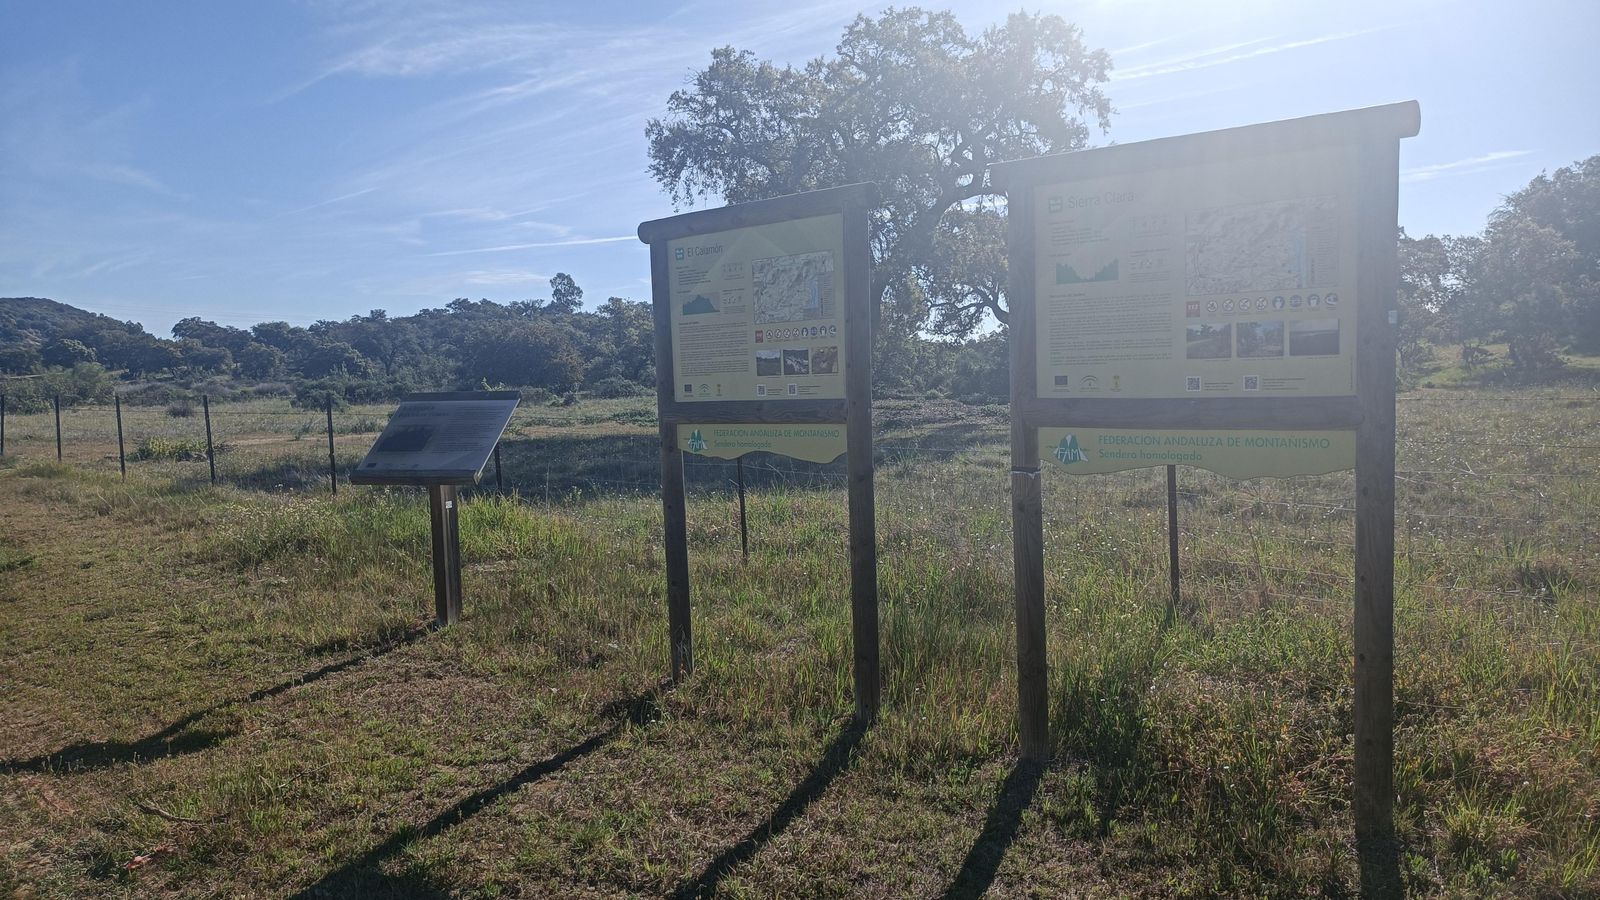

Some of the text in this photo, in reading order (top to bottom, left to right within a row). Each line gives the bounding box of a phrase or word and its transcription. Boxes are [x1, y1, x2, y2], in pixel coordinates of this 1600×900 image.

[1066, 191, 1136, 209] Sierra Clara
[687, 247, 694, 257] El
[750, 429, 783, 437] ANDALUZA
[784, 429, 792, 437] DE
[1163, 435, 1223, 446] ANDALUZA
[1227, 436, 1241, 447] DE
[1245, 434, 1331, 448] MONTAÑISMO
[1057, 447, 1080, 462] FAM
[1098, 448, 1203, 463] Sendero homologado
